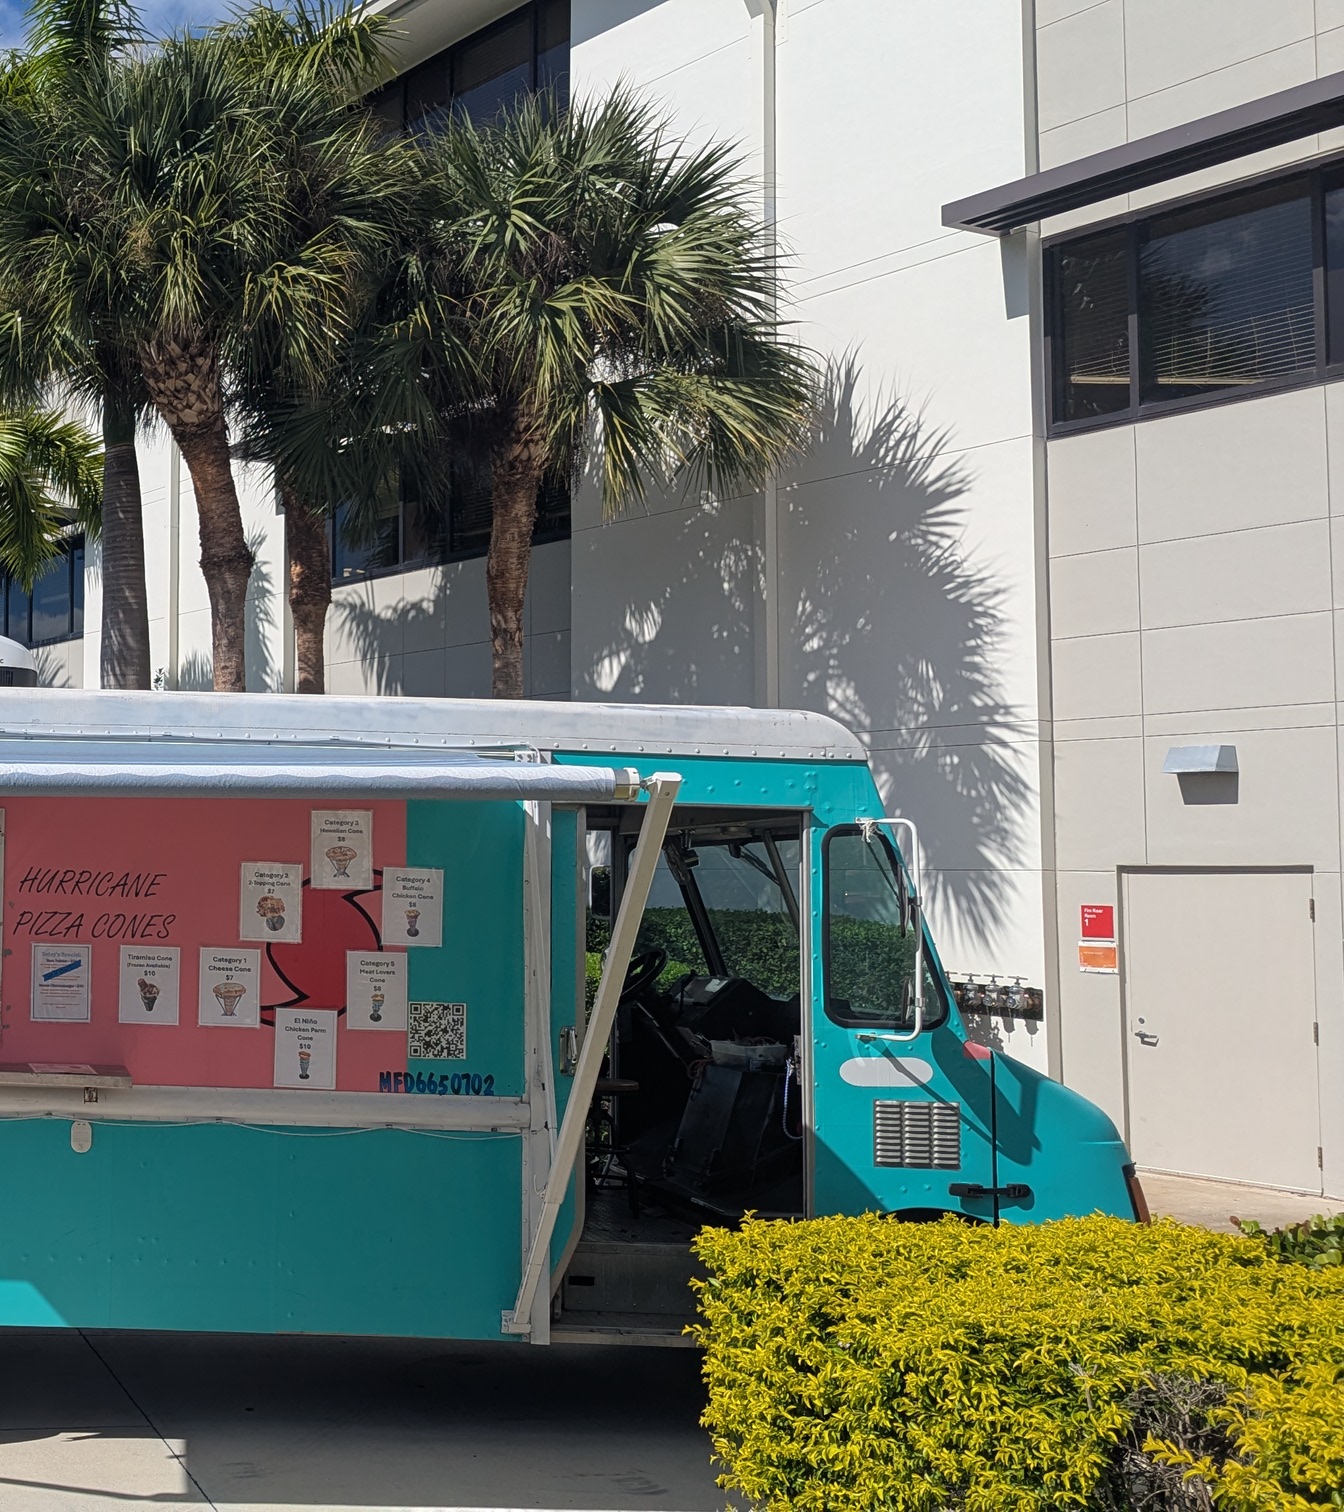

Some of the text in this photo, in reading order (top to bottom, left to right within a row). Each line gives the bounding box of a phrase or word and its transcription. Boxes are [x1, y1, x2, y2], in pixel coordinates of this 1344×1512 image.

[18, 866, 167, 898] HURRICANE
[13, 910, 176, 939] PIZZA CONES
[379, 1070, 494, 1096] MFD6650702
